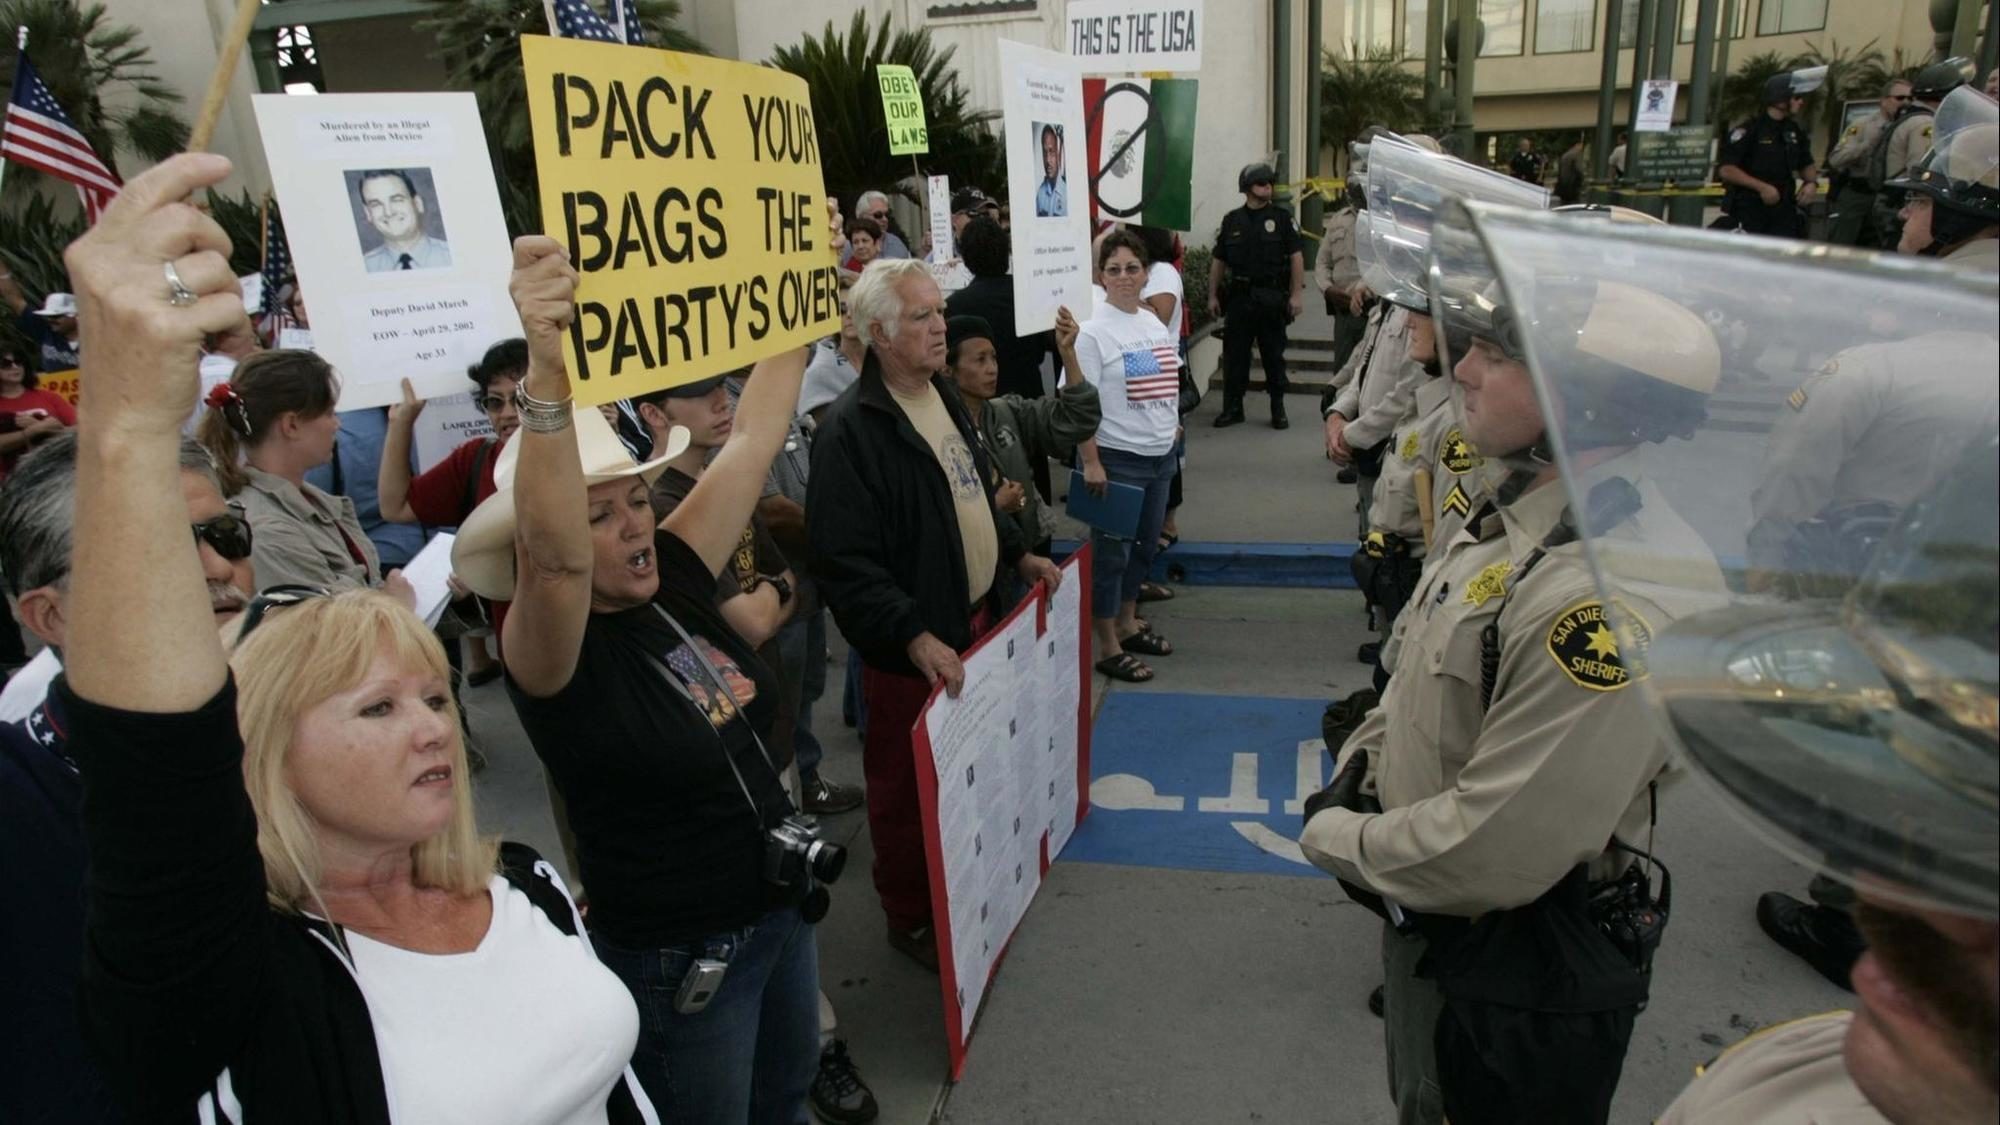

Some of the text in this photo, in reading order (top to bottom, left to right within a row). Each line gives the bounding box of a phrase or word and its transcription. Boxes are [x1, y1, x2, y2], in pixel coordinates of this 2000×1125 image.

[1071, 9, 1195, 55] THIS IS THE USA
[881, 76, 917, 95] OBEY
[552, 72, 817, 165] PACK YOUR
[890, 102, 919, 119] OUR
[320, 120, 431, 132] Murdered by an Illegal
[335, 131, 422, 142] Alien from Mexico
[890, 128, 928, 146] LAWS
[562, 187, 813, 272] BAGS THE
[370, 299, 469, 318] Deputy David March
[373, 328, 400, 342] EOW
[412, 326, 436, 338] April
[438, 323, 451, 334] 29,
[453, 320, 475, 332] 2002
[569, 265, 841, 381] PARTY'S OVER
[415, 347, 447, 361] Age 33
[1553, 617, 1578, 646] SAN
[1570, 656, 1629, 682] SHERIFF
